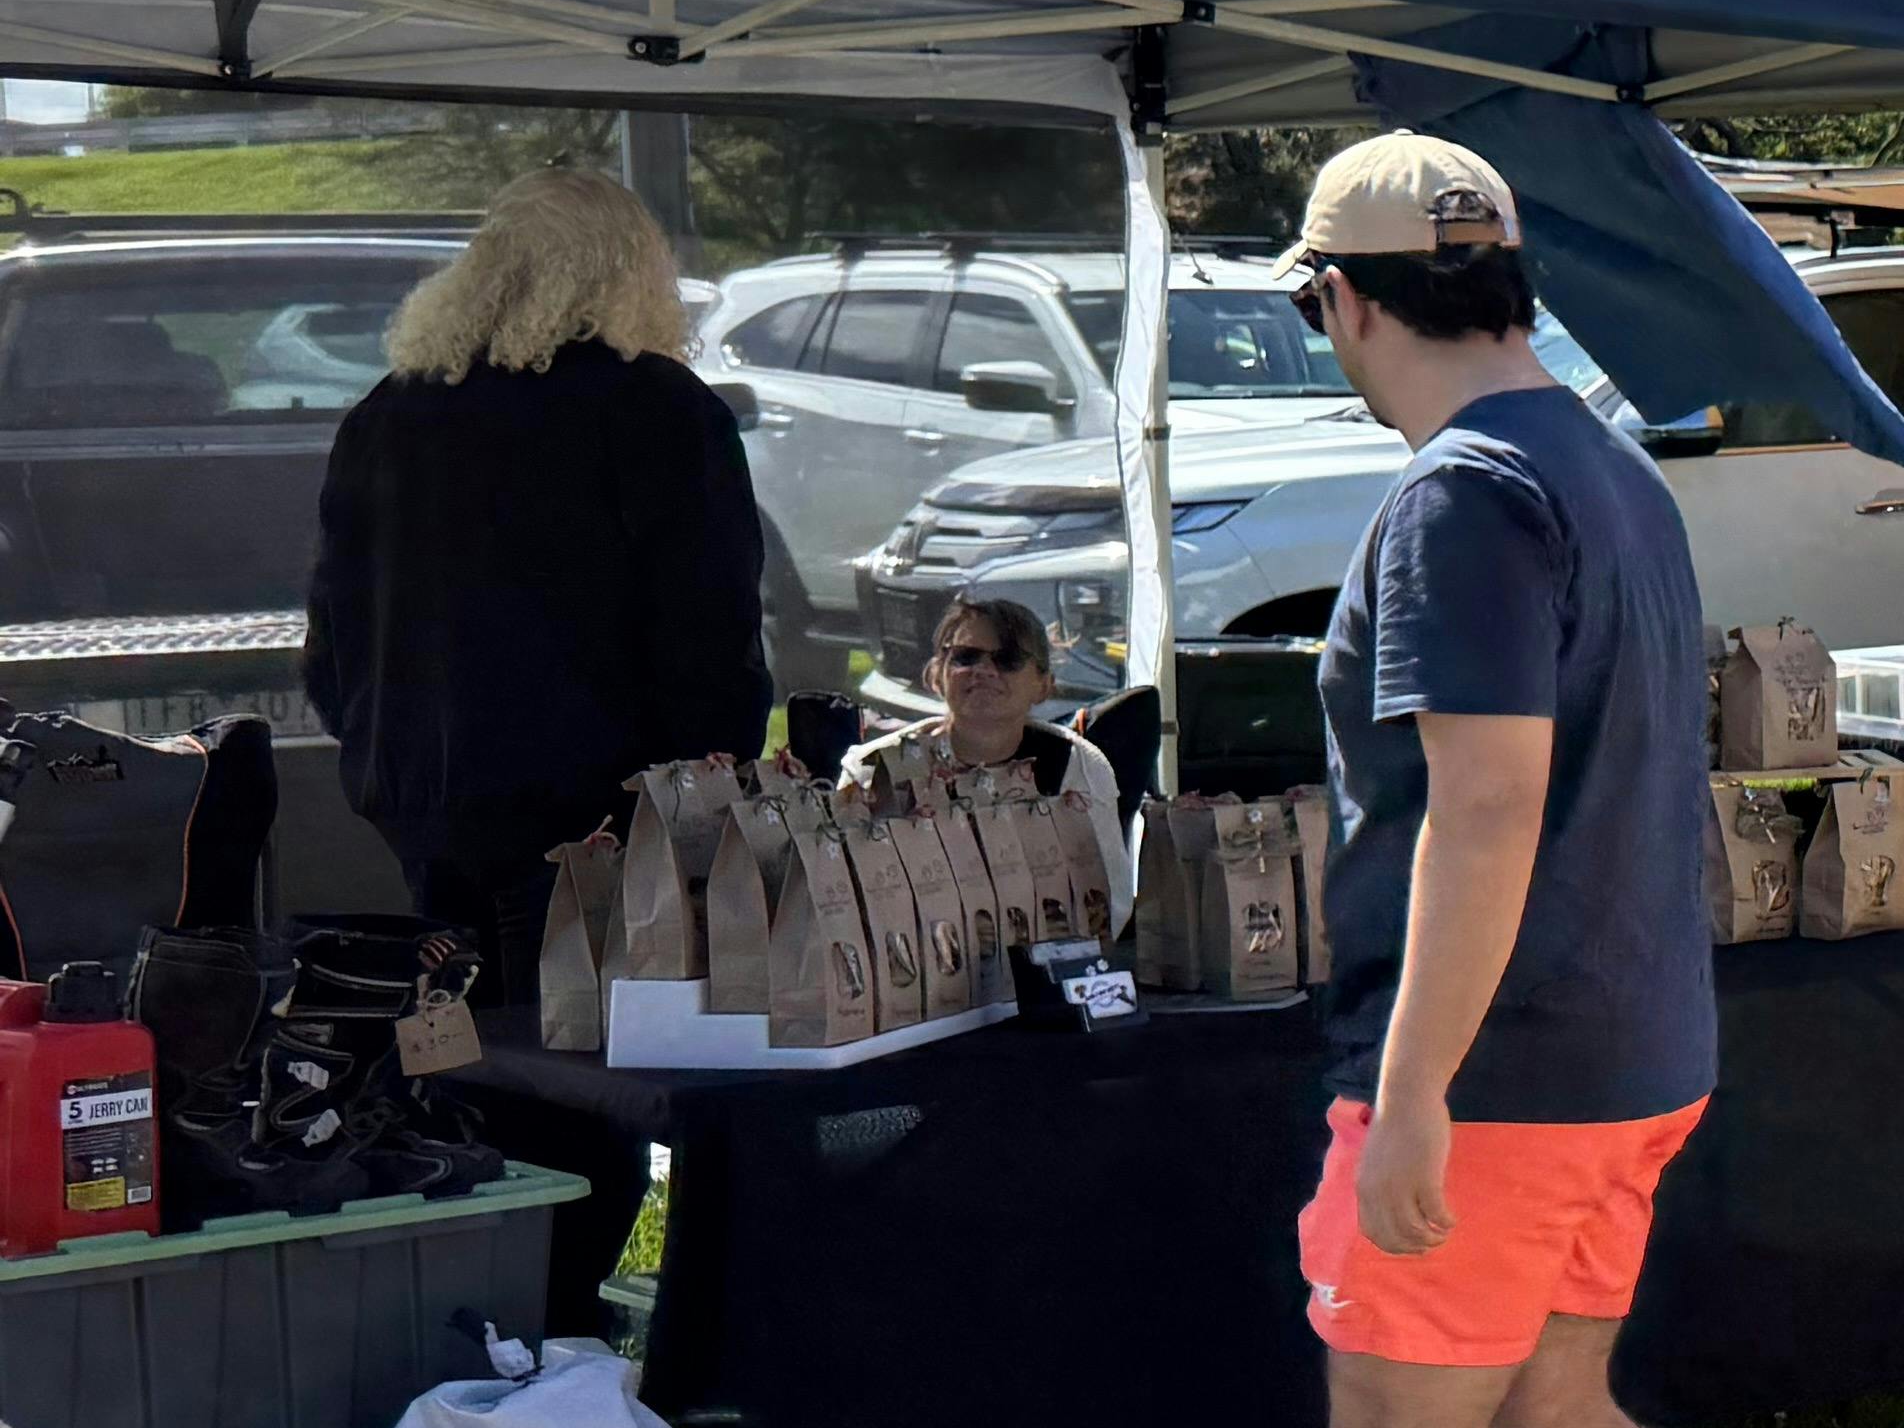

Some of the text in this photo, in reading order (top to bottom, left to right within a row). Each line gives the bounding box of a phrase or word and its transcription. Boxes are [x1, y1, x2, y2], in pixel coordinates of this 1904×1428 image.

[68, 1096, 149, 1121] 5 JERRY CAN
